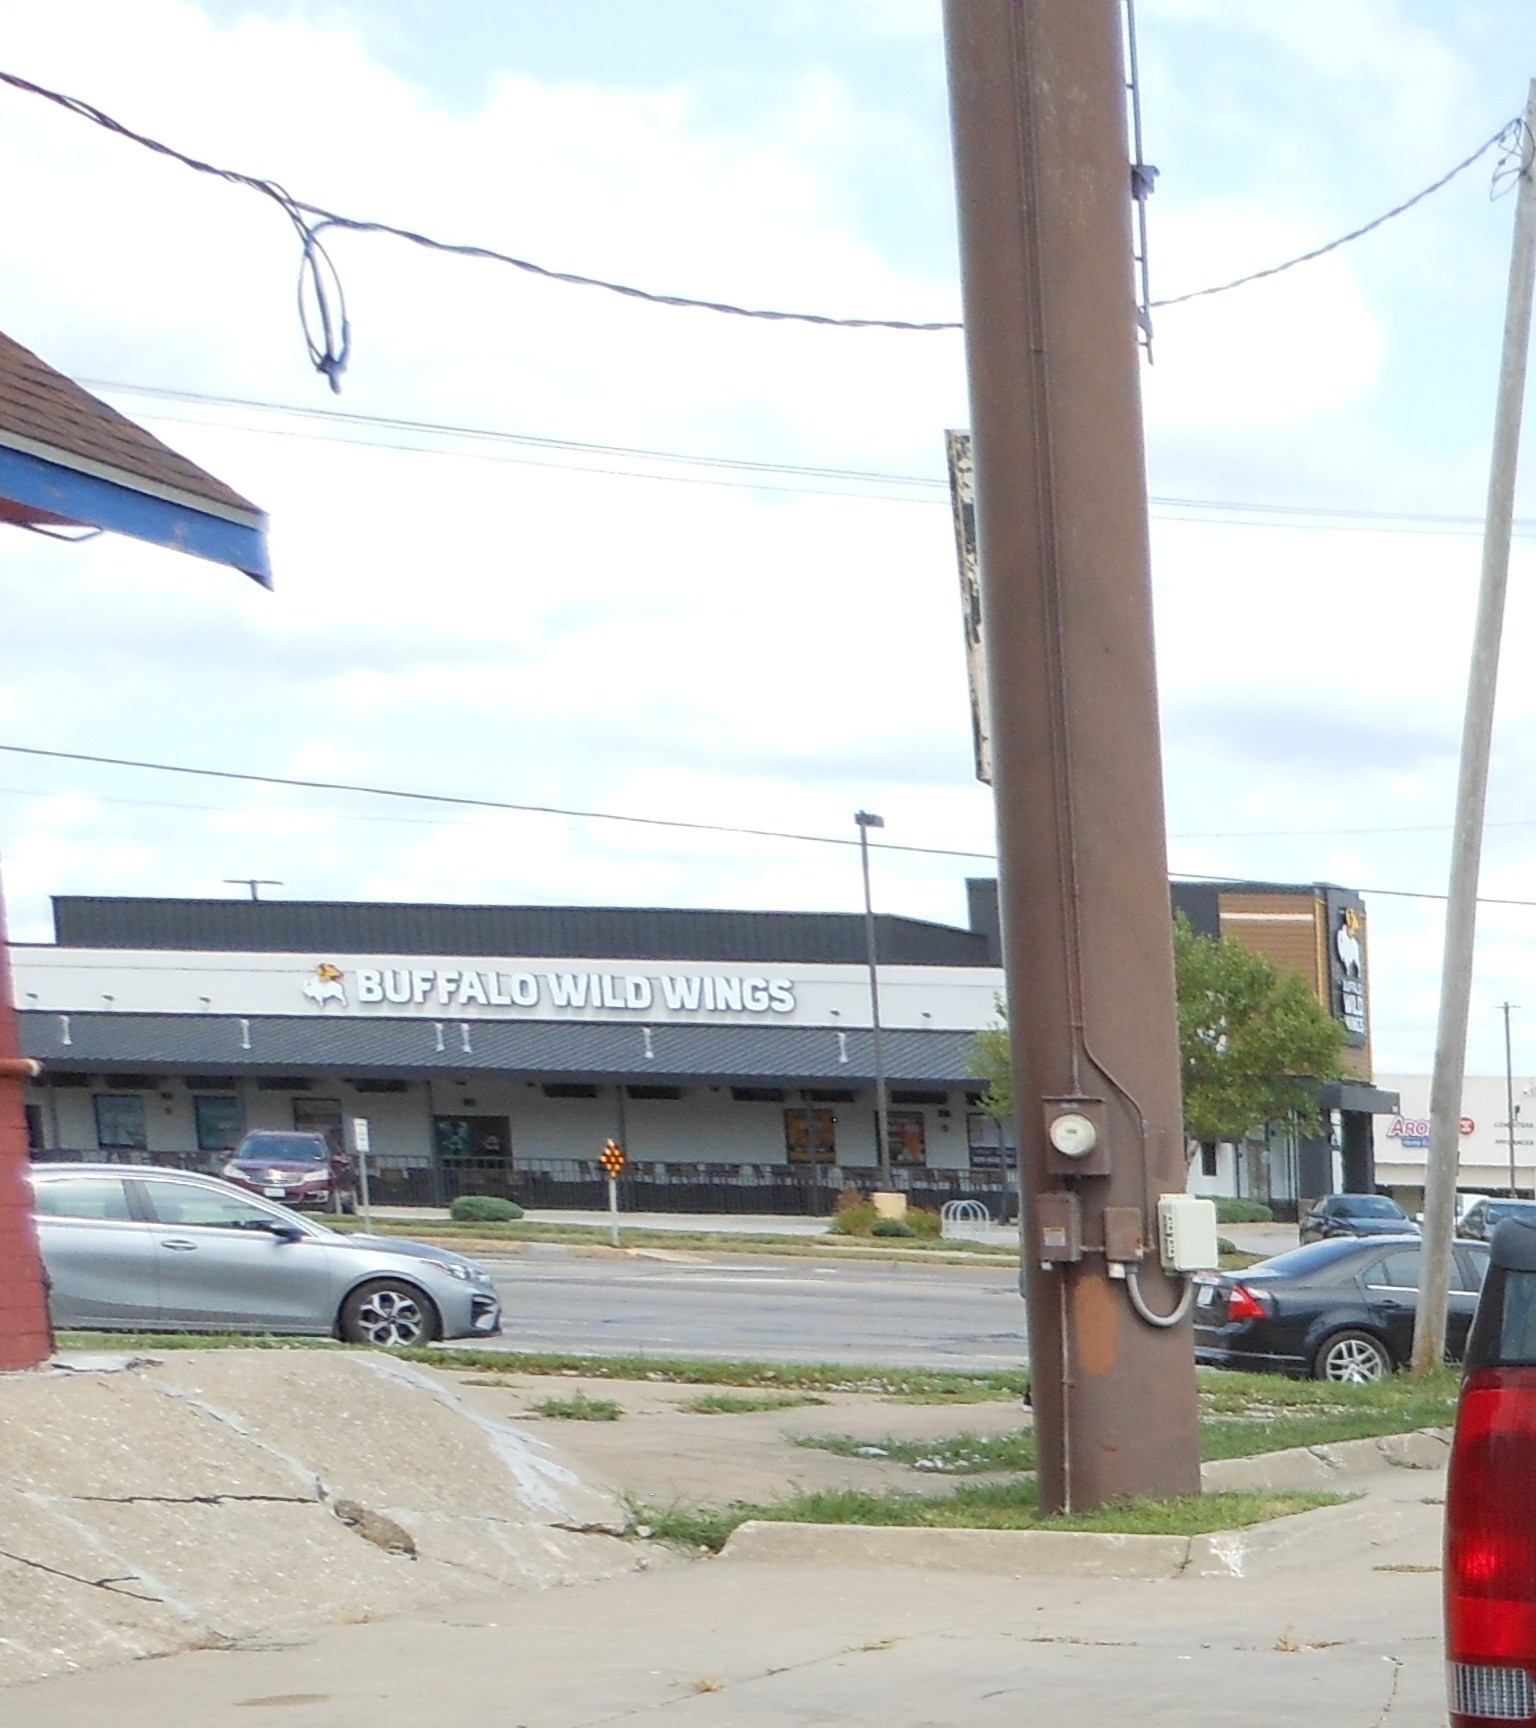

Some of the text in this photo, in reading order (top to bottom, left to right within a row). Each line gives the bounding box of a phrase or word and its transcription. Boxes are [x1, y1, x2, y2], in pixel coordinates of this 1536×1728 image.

[357, 969, 795, 1012] BUFFALO WILD WINGS
